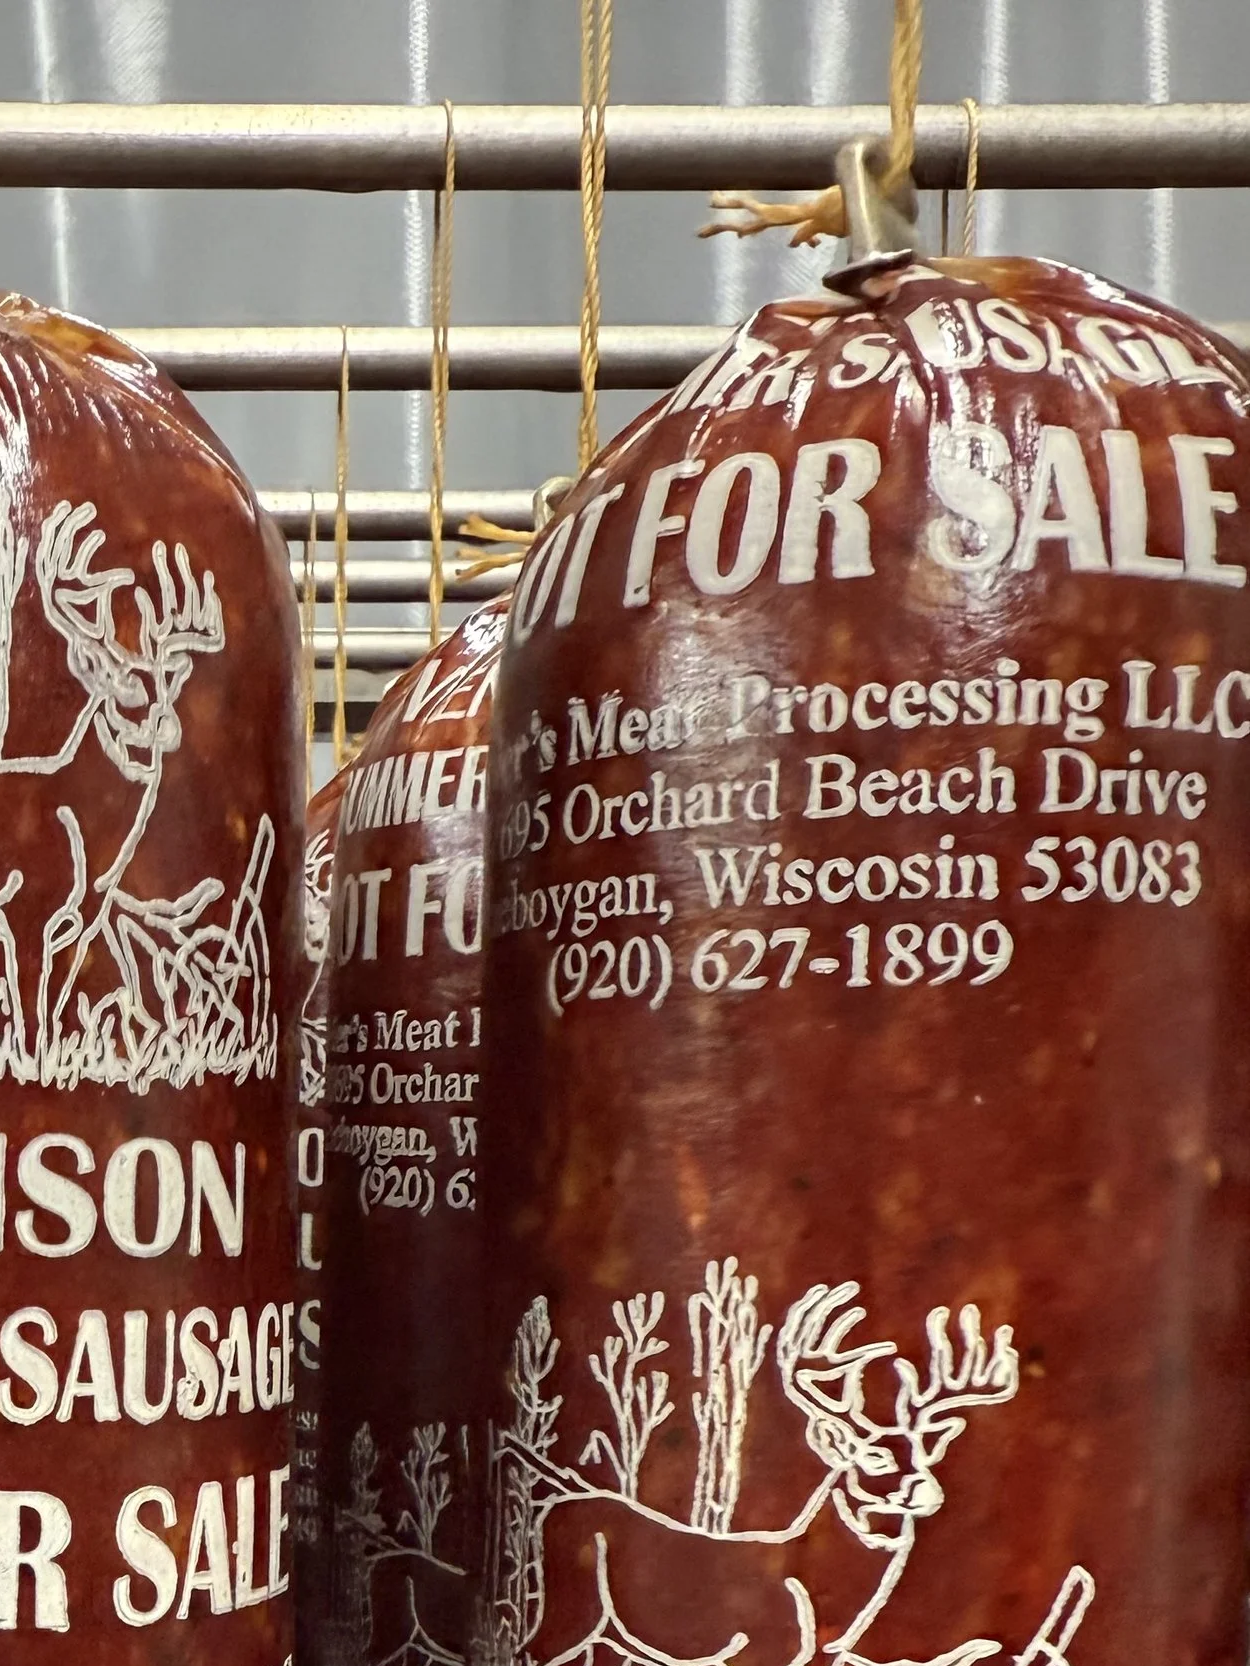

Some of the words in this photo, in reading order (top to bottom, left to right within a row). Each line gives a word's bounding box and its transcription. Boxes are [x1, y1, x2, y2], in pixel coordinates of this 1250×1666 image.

[513, 482, 626, 647] OT
[623, 437, 882, 609] FOR
[925, 423, 1248, 588] SALE
[726, 658, 1110, 742] Processing
[1122, 660, 1250, 739] LLC
[562, 758, 782, 845] Orchard
[805, 747, 1018, 821] Beach
[1040, 746, 1208, 821] Drive
[338, 867, 392, 967] OT
[405, 858, 483, 957] FO
[693, 836, 1001, 910] Wiscosin
[1022, 836, 1203, 908] 53083
[548, 933, 674, 1018] (920)
[690, 919, 1016, 992] 627-1899
[373, 1008, 462, 1053] Meat
[370, 1061, 480, 1105] Orchar
[359, 1165, 436, 1217] (920)
[111, 1461, 291, 1628] SALE
